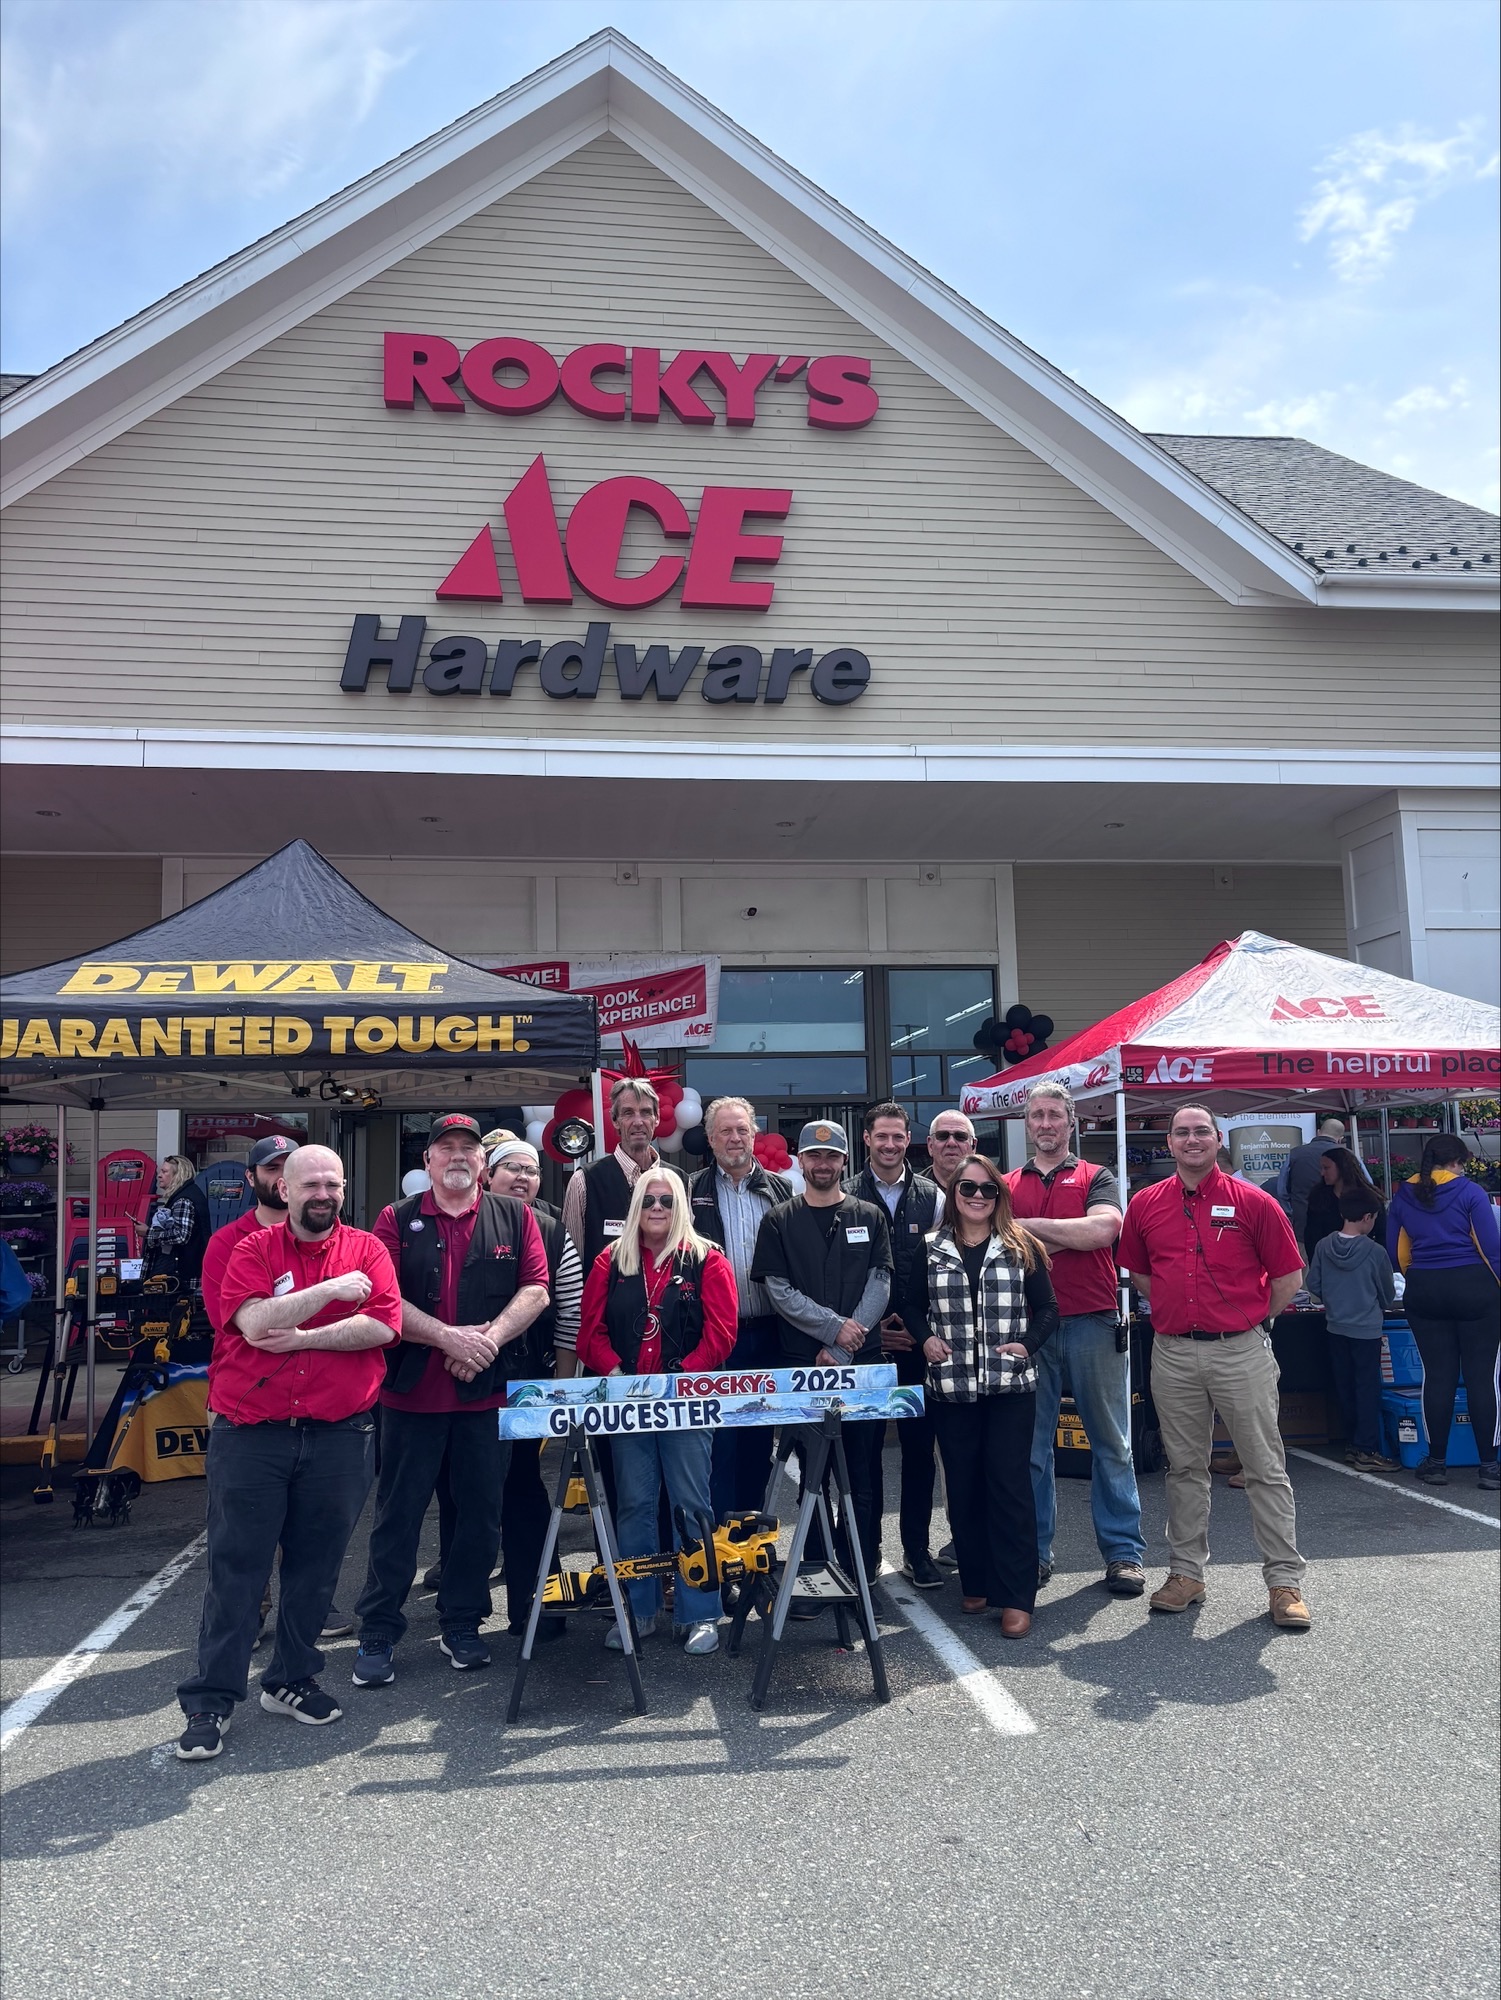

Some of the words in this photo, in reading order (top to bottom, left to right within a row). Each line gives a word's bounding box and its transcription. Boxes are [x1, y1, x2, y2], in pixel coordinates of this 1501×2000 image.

[383, 332, 880, 430] ROCKY'S
[435, 452, 793, 612] ACE
[340, 614, 871, 705] Hardware
[599, 994, 696, 1027] XPERIENCE!
[1269, 995, 1386, 1020] ACE
[684, 1023, 712, 1035] ACE
[1146, 1055, 1214, 1083] ACE
[1256, 1053, 1315, 1074] The
[1326, 1052, 1430, 1077] helpful
[992, 1091, 1009, 1108] The
[442, 1115, 473, 1127] ACE
[1240, 1142, 1269, 1150] Benjamin
[791, 1368, 856, 1392] 2025
